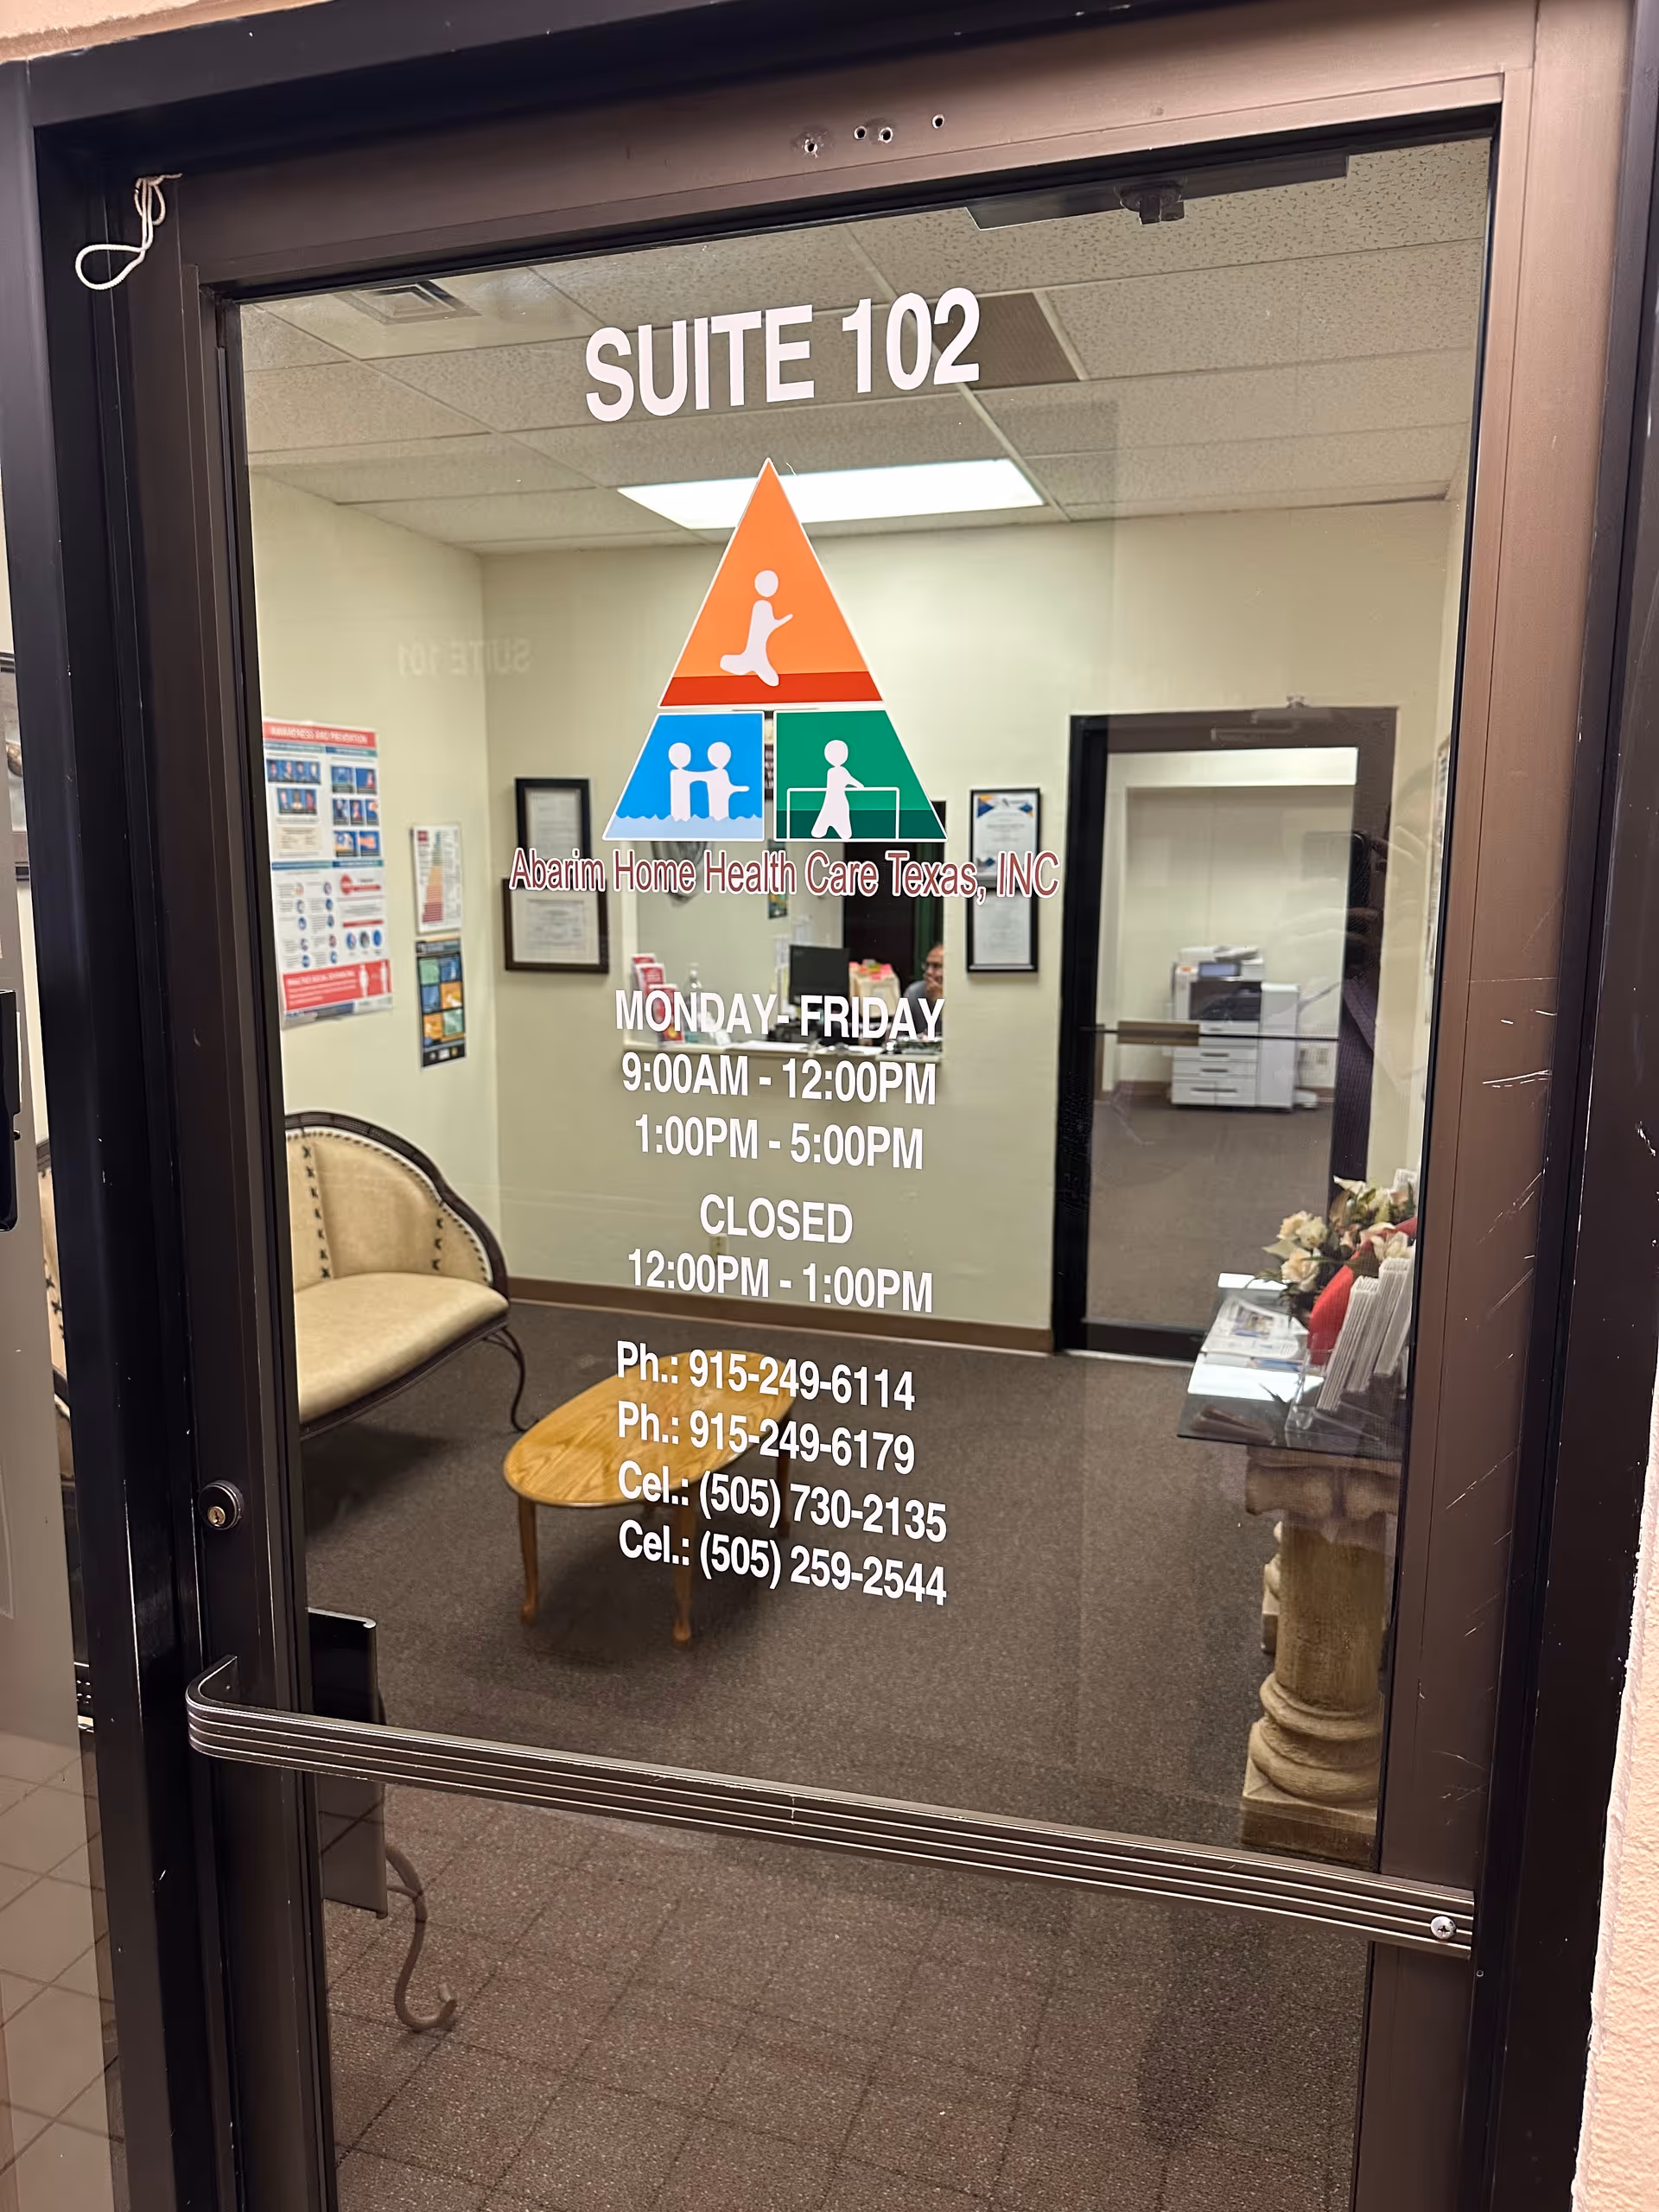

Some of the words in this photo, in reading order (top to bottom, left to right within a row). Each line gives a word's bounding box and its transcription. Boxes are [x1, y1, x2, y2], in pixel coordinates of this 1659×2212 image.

[586, 304, 815, 423] SUITE
[842, 287, 981, 393] 102
[509, 848, 606, 892] Abarim
[613, 849, 696, 893] Home
[704, 849, 797, 894] Health
[804, 849, 879, 896] Care
[885, 850, 987, 906] Texas,
[995, 850, 1060, 898] INC
[800, 995, 945, 1040] FRIDAY
[621, 1051, 749, 1096] 9:00AM
[759, 1076, 772, 1086] -
[782, 1058, 936, 1105] 12:00PM
[635, 1113, 758, 1160] 1:00PM
[768, 1140, 781, 1150] -
[790, 1122, 924, 1170] 5:00PM
[700, 1193, 854, 1244] CLOSED
[628, 1248, 769, 1298] 12:00PM
[779, 1278, 792, 1289] -
[802, 1262, 933, 1313] 1:00PM
[616, 1340, 678, 1384] Ph.:
[689, 1349, 916, 1411] 915-249-6114
[618, 1400, 680, 1445] Ph.:
[690, 1409, 916, 1475] 915-249-6179
[618, 1459, 690, 1507] Cel.:
[699, 1470, 781, 1529] (505)
[790, 1483, 948, 1544] 730-2135
[619, 1519, 690, 1566] Cel.:
[700, 1530, 782, 1590] (505)
[790, 1545, 947, 1606] 259-2544
